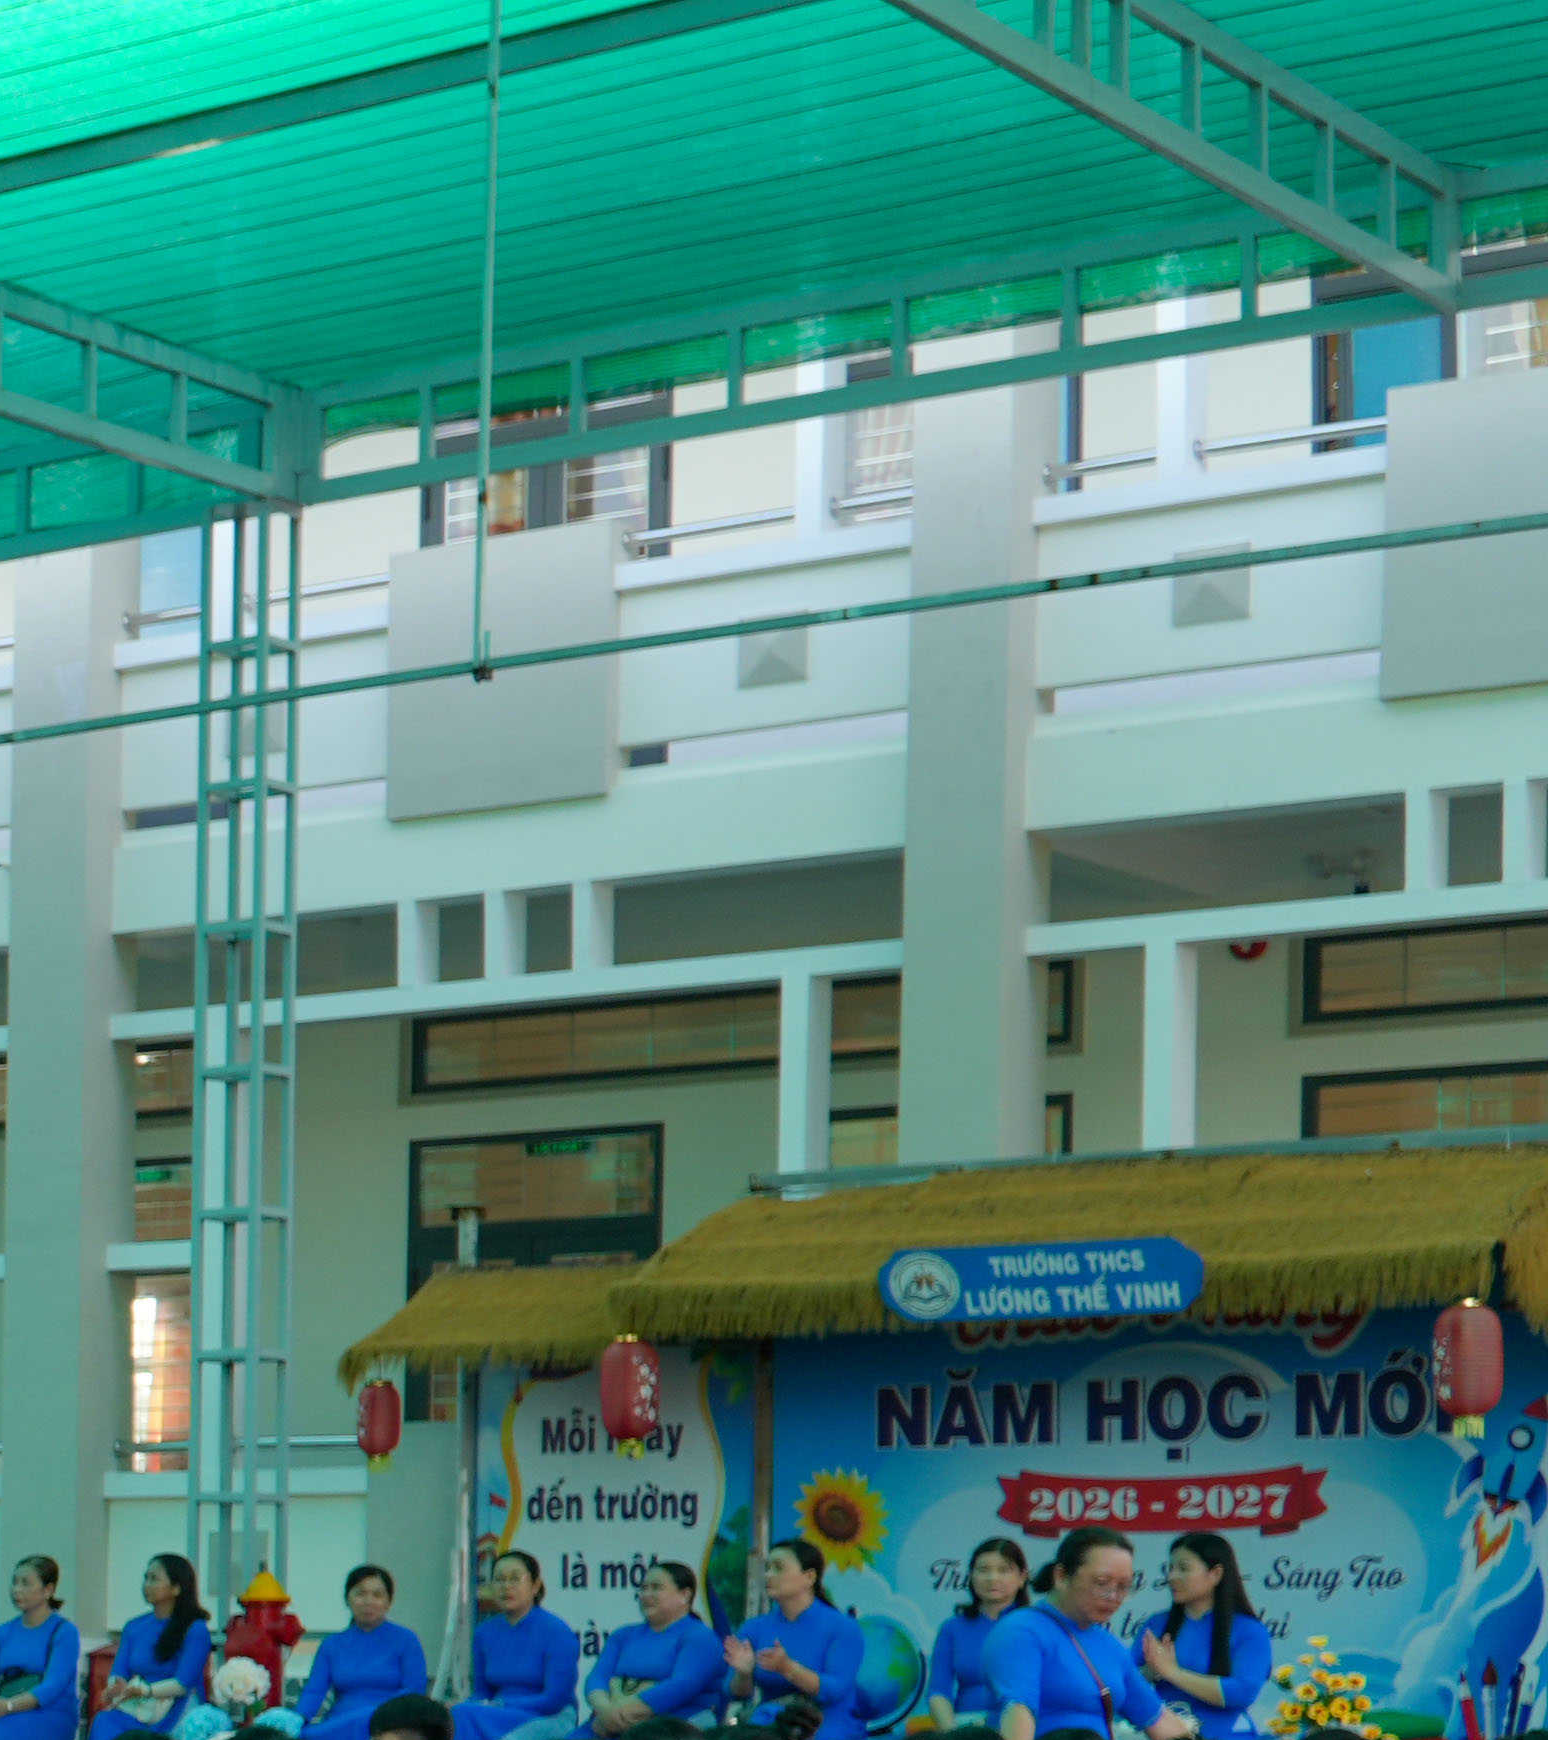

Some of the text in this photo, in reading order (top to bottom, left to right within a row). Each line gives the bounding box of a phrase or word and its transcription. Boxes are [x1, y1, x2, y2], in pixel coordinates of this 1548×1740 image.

[1084, 1248, 1146, 1274] THCS
[962, 1271, 1182, 1317] LƯƠNG THẾ VINH
[541, 1407, 596, 1454] Mỗi
[876, 1367, 1054, 1447] NĂM
[1086, 1374, 1264, 1463] HỌC
[594, 1483, 699, 1528] trường
[1028, 1486, 1139, 1522] 2026
[1178, 1484, 1291, 1519] 2027
[562, 1552, 588, 1590] là
[1263, 1554, 1405, 1601] Sáng Tạo
